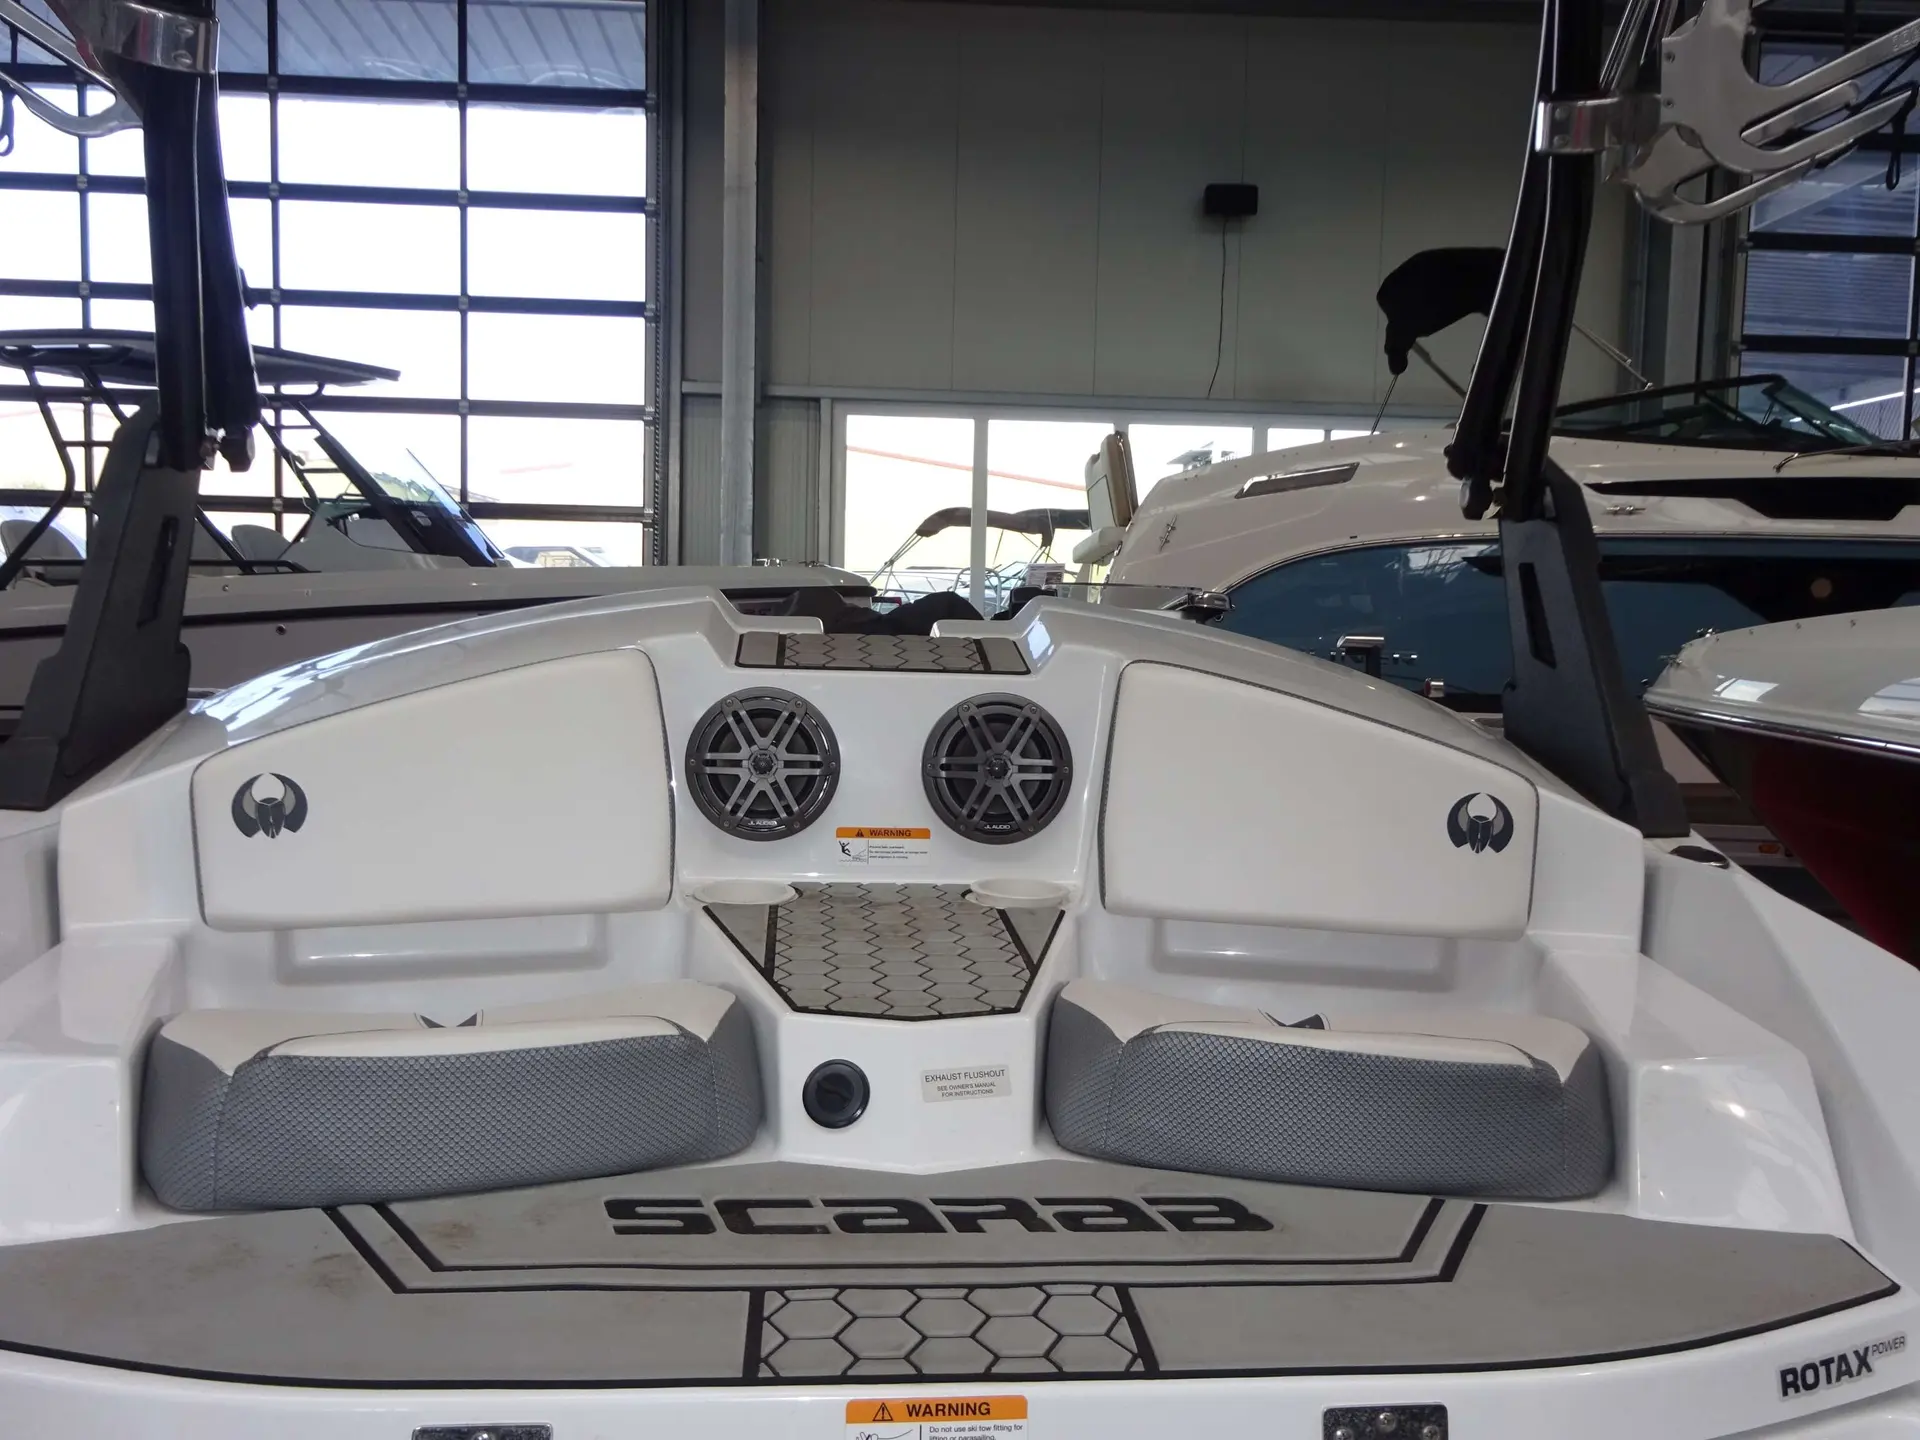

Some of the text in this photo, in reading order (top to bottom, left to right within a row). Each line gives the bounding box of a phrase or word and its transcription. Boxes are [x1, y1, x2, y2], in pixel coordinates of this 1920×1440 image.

[869, 829, 912, 837] WARNING
[924, 1069, 1006, 1083] EXHAUST FLUSHOUT
[954, 1088, 994, 1097] INSTRUCTIONS
[1780, 1335, 1906, 1398] ROTAX POWER
[906, 1401, 991, 1418] WARNING
[993, 1424, 1013, 1433] fitting
